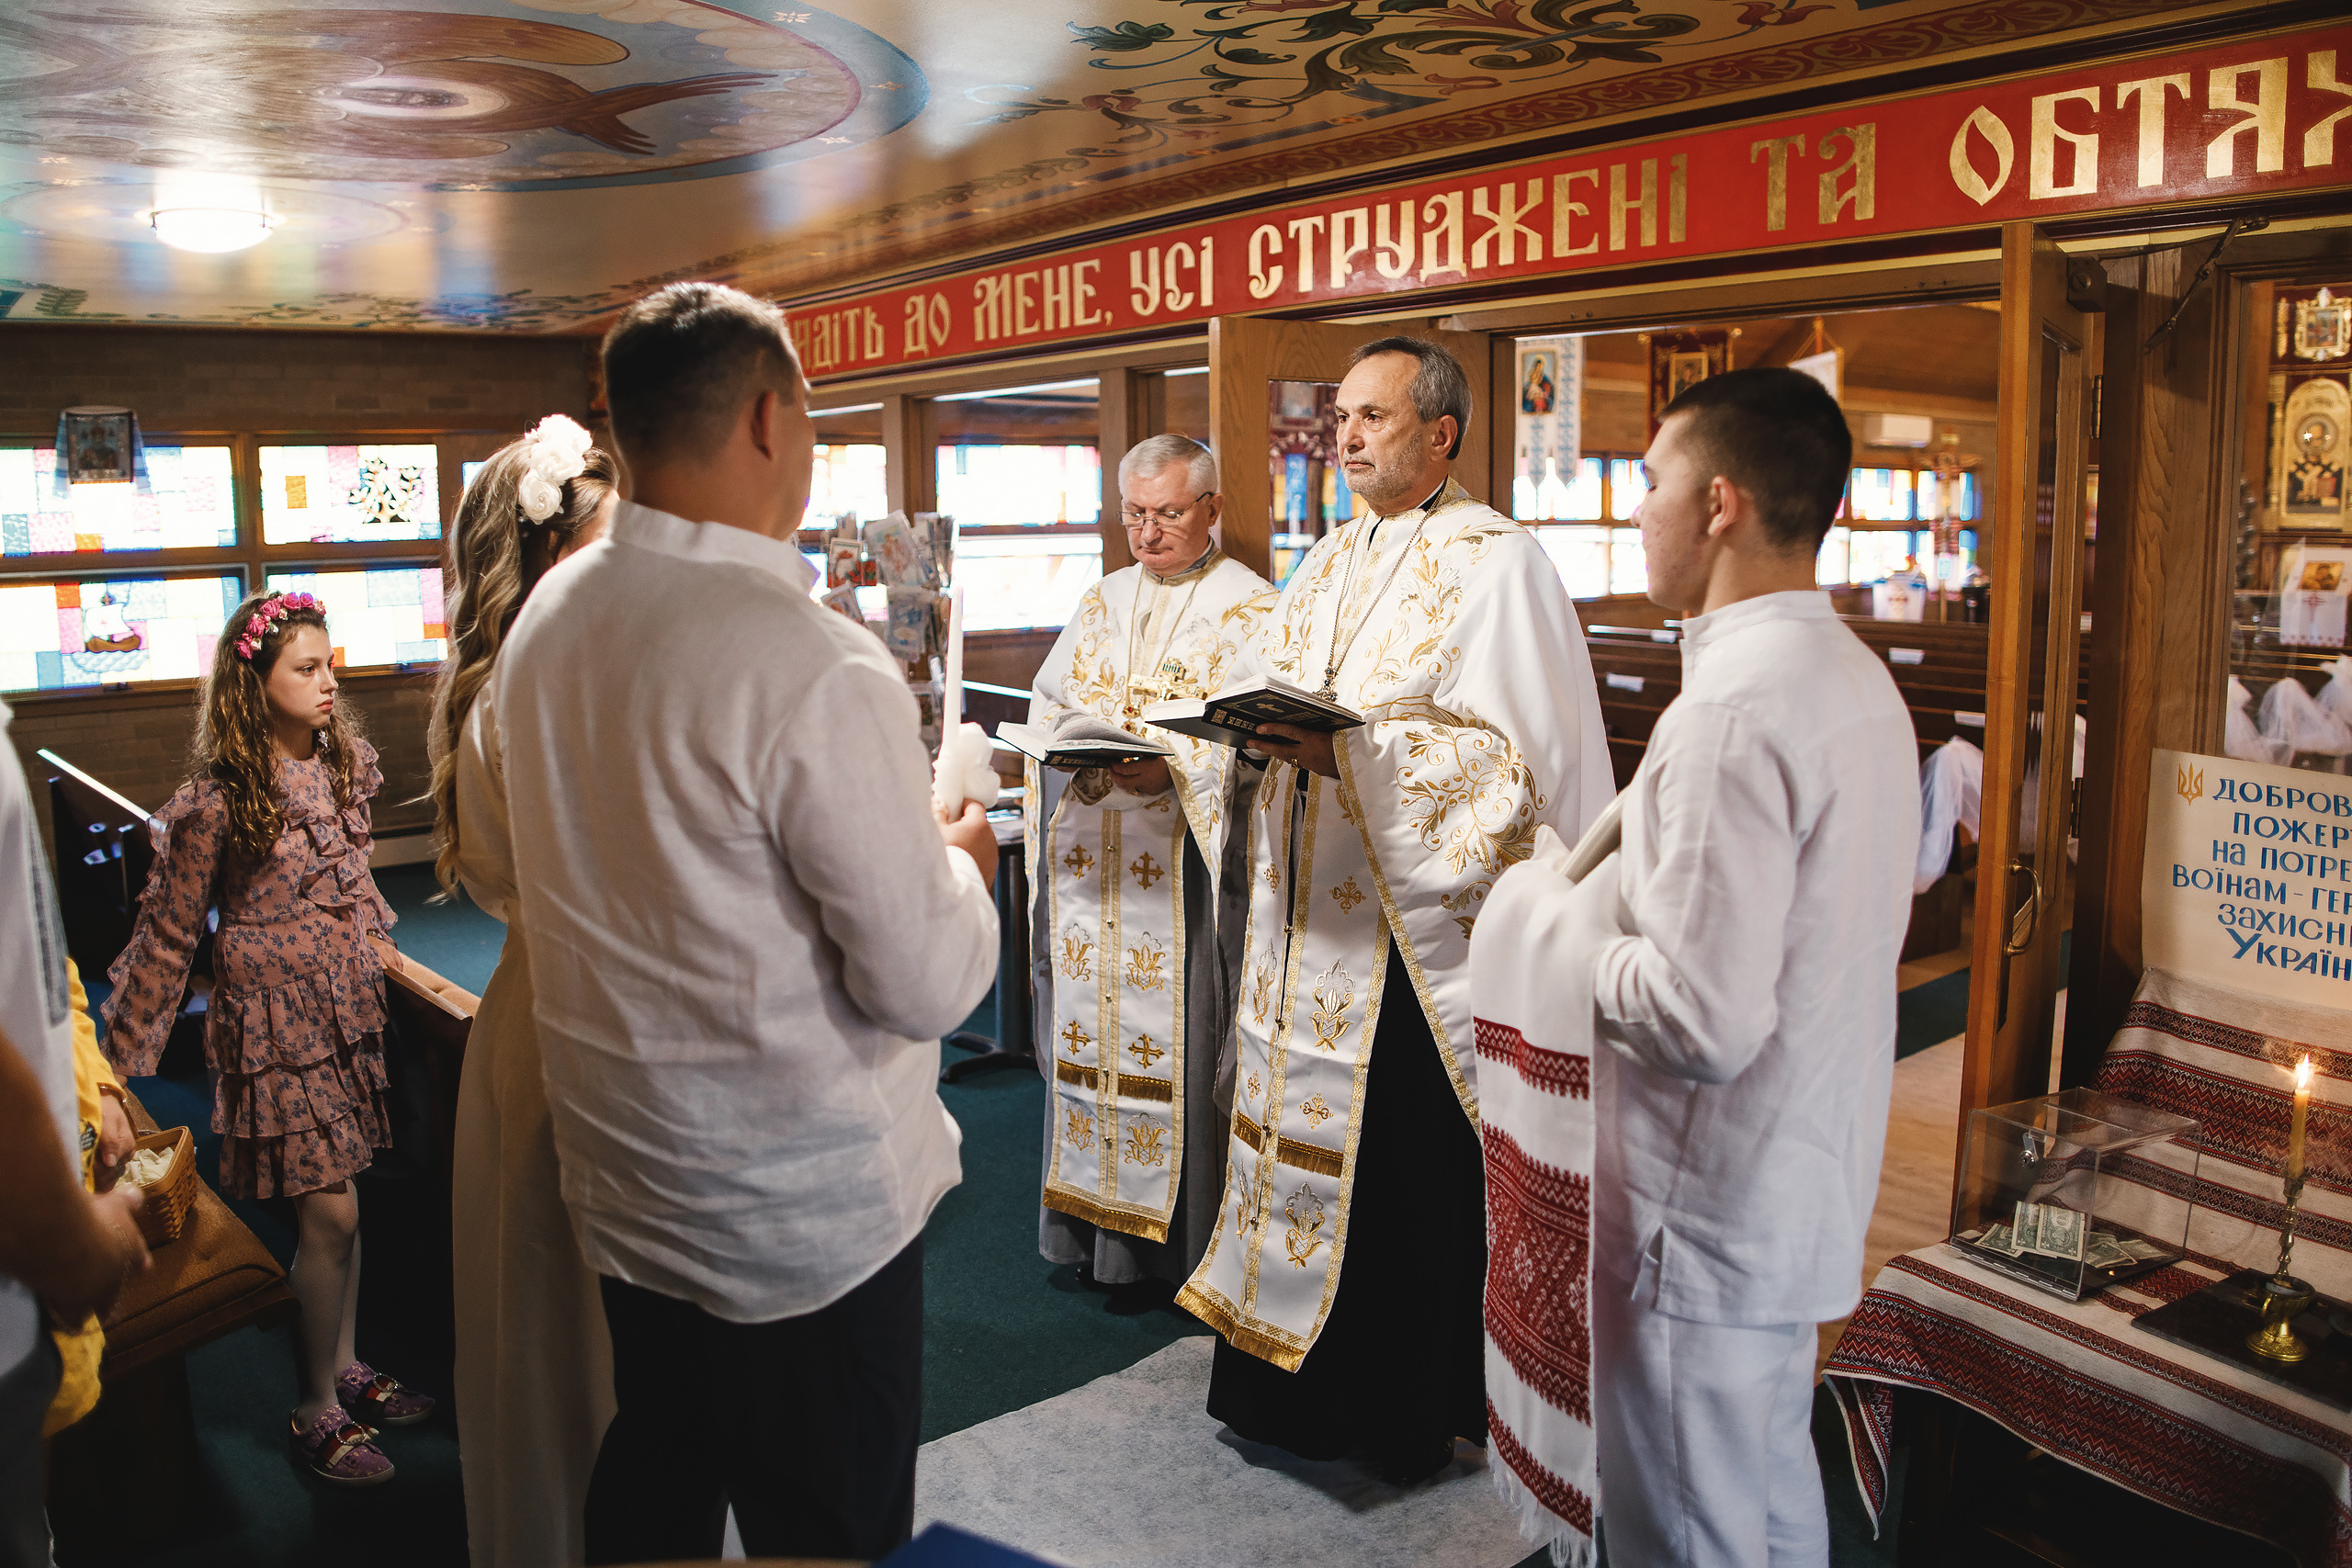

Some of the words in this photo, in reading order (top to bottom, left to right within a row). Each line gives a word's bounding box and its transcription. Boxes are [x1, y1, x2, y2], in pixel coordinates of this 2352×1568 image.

[903, 292, 952, 360] ДО
[973, 258, 1114, 343] МЕНЕ,
[1129, 235, 1215, 317] УСІ
[1248, 152, 1688, 300] СТРУДЖЕНІ
[1750, 122, 1877, 232] ТА
[2211, 778, 2352, 818] ДОБРОВ
[2233, 811, 2352, 849] ПОЖЕР
[2260, 846, 2352, 883] ПОТРЕ
[2217, 903, 2352, 948] ЗАХИСН
